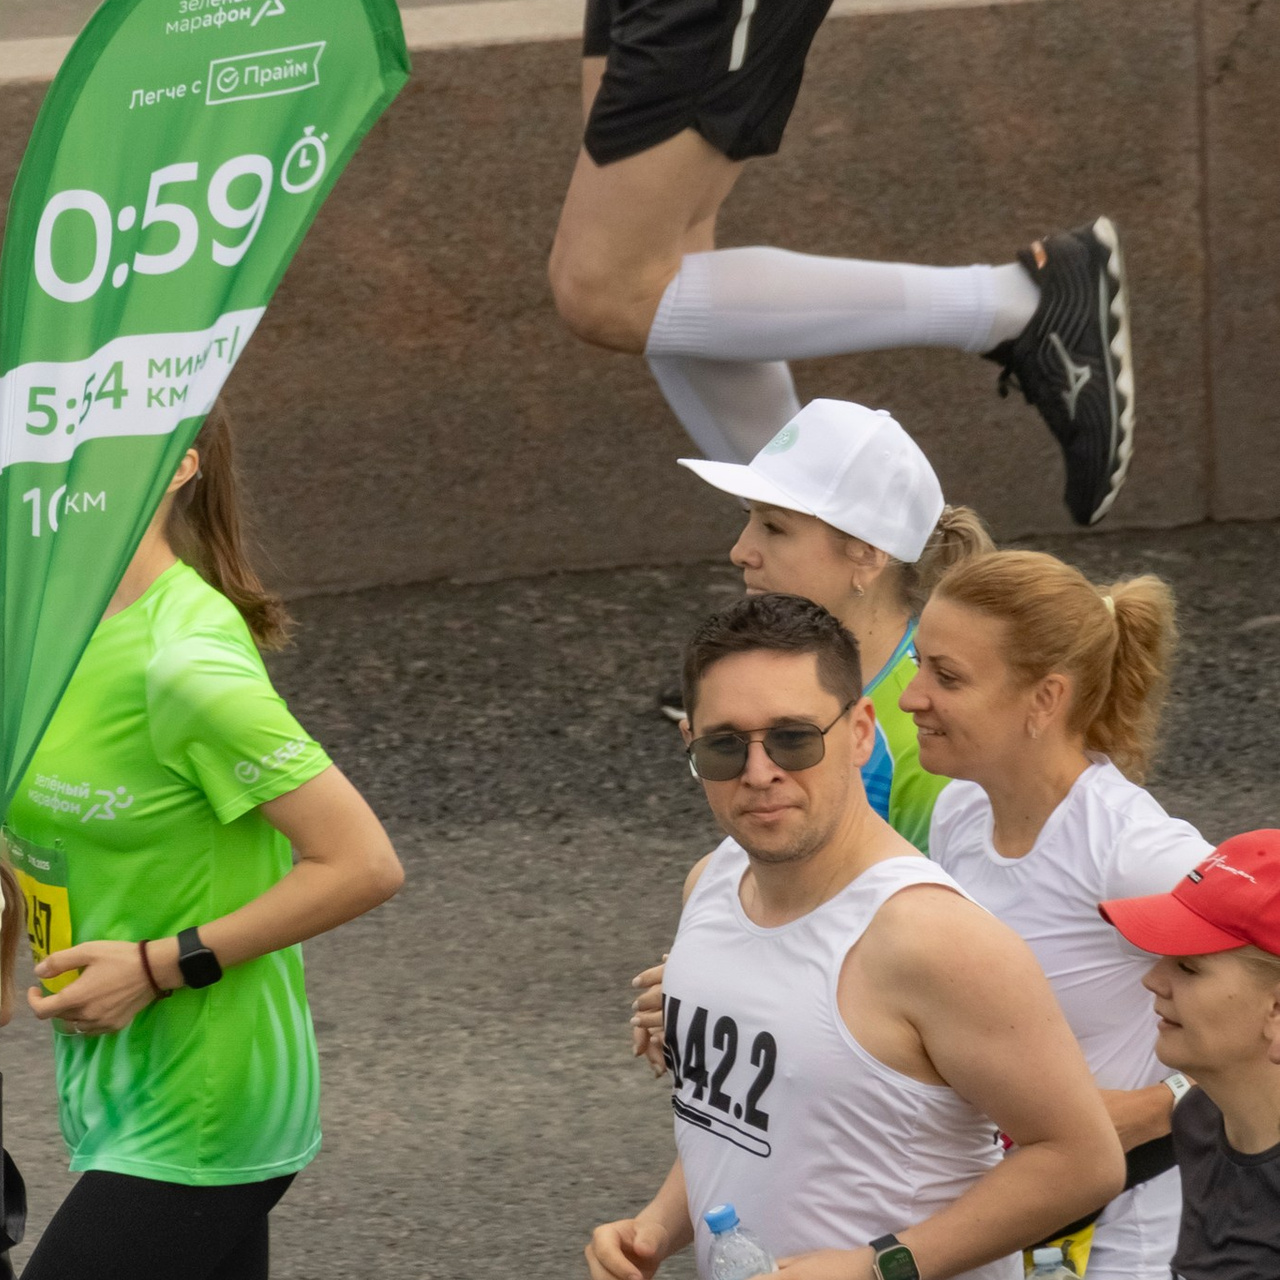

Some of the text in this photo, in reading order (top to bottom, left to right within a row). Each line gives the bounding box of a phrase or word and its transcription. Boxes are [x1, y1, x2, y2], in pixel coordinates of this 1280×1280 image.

[166, 6, 251, 35] марафон
[129, 58, 308, 110] Легче с Прайм
[34, 153, 274, 303] 0:59
[25, 360, 129, 436] 5:54
[146, 384, 189, 409] км
